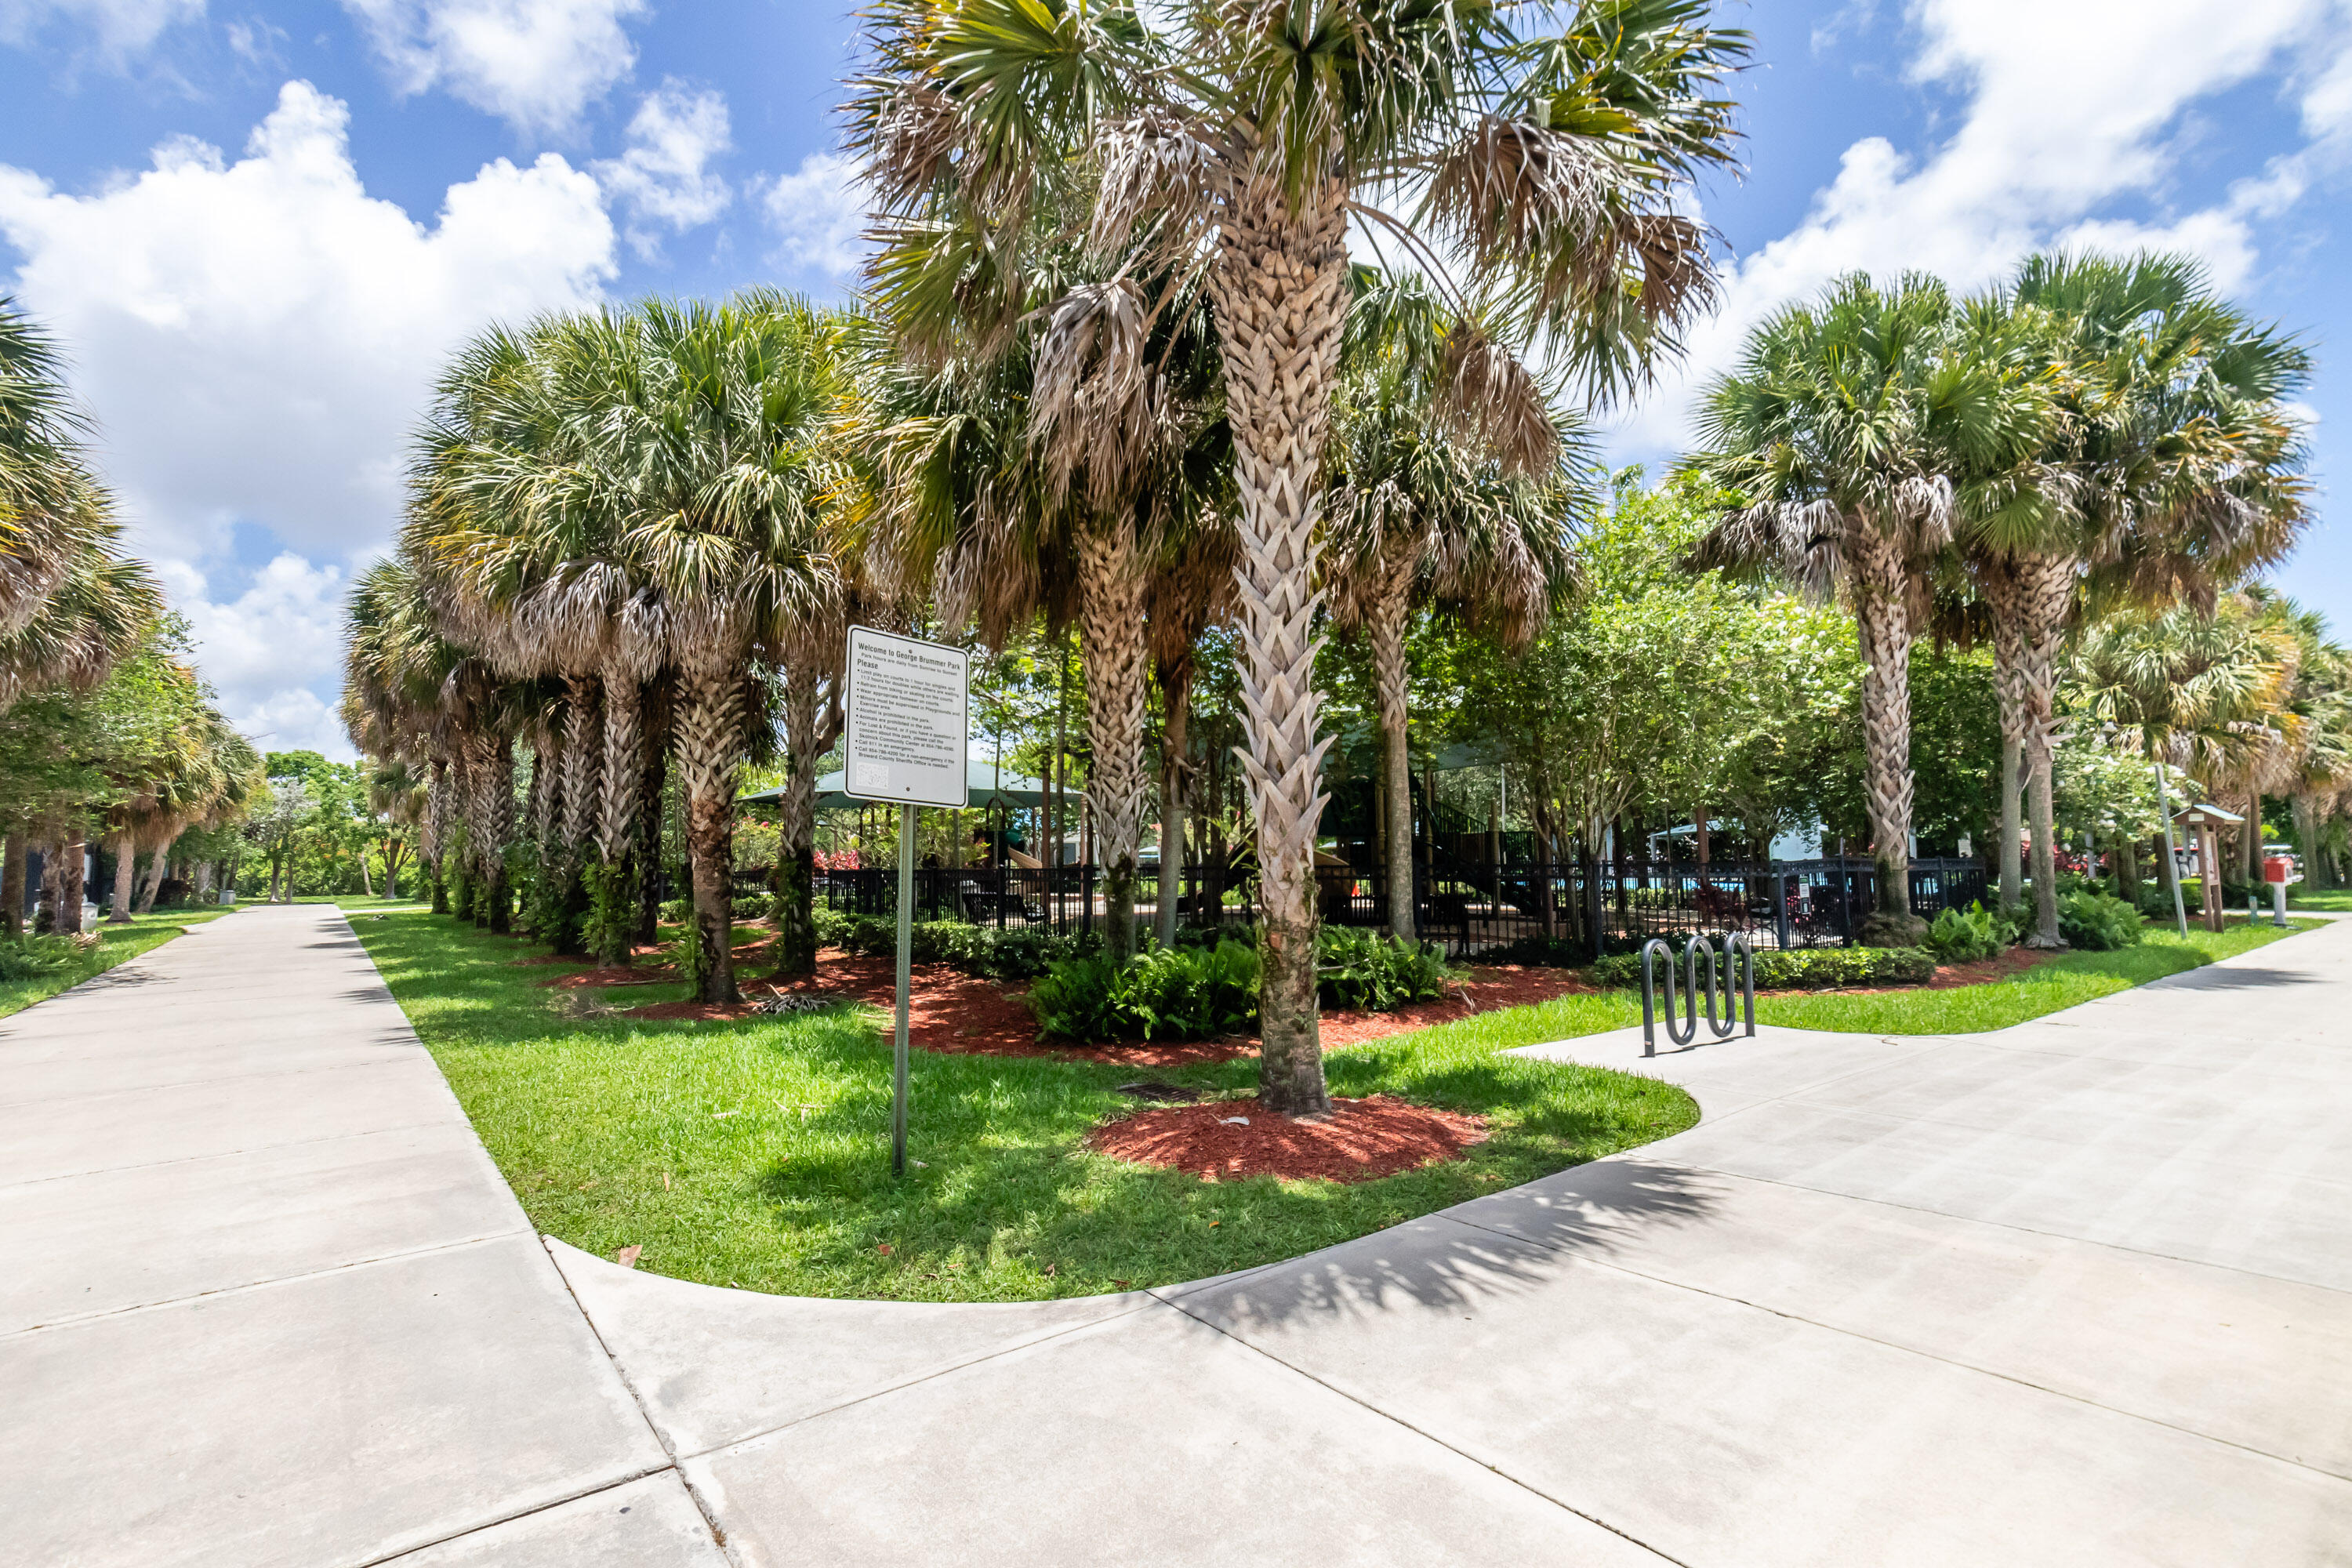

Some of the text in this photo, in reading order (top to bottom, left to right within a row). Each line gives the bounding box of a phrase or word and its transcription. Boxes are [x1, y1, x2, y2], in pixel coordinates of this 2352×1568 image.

[858, 642, 887, 655] Welcome
[896, 650, 917, 662] George
[920, 655, 946, 667] Brummer
[948, 661, 960, 670] Park
[857, 659, 878, 670] Please
[883, 711, 905, 720] prohibited
[880, 736, 904, 745] Community
